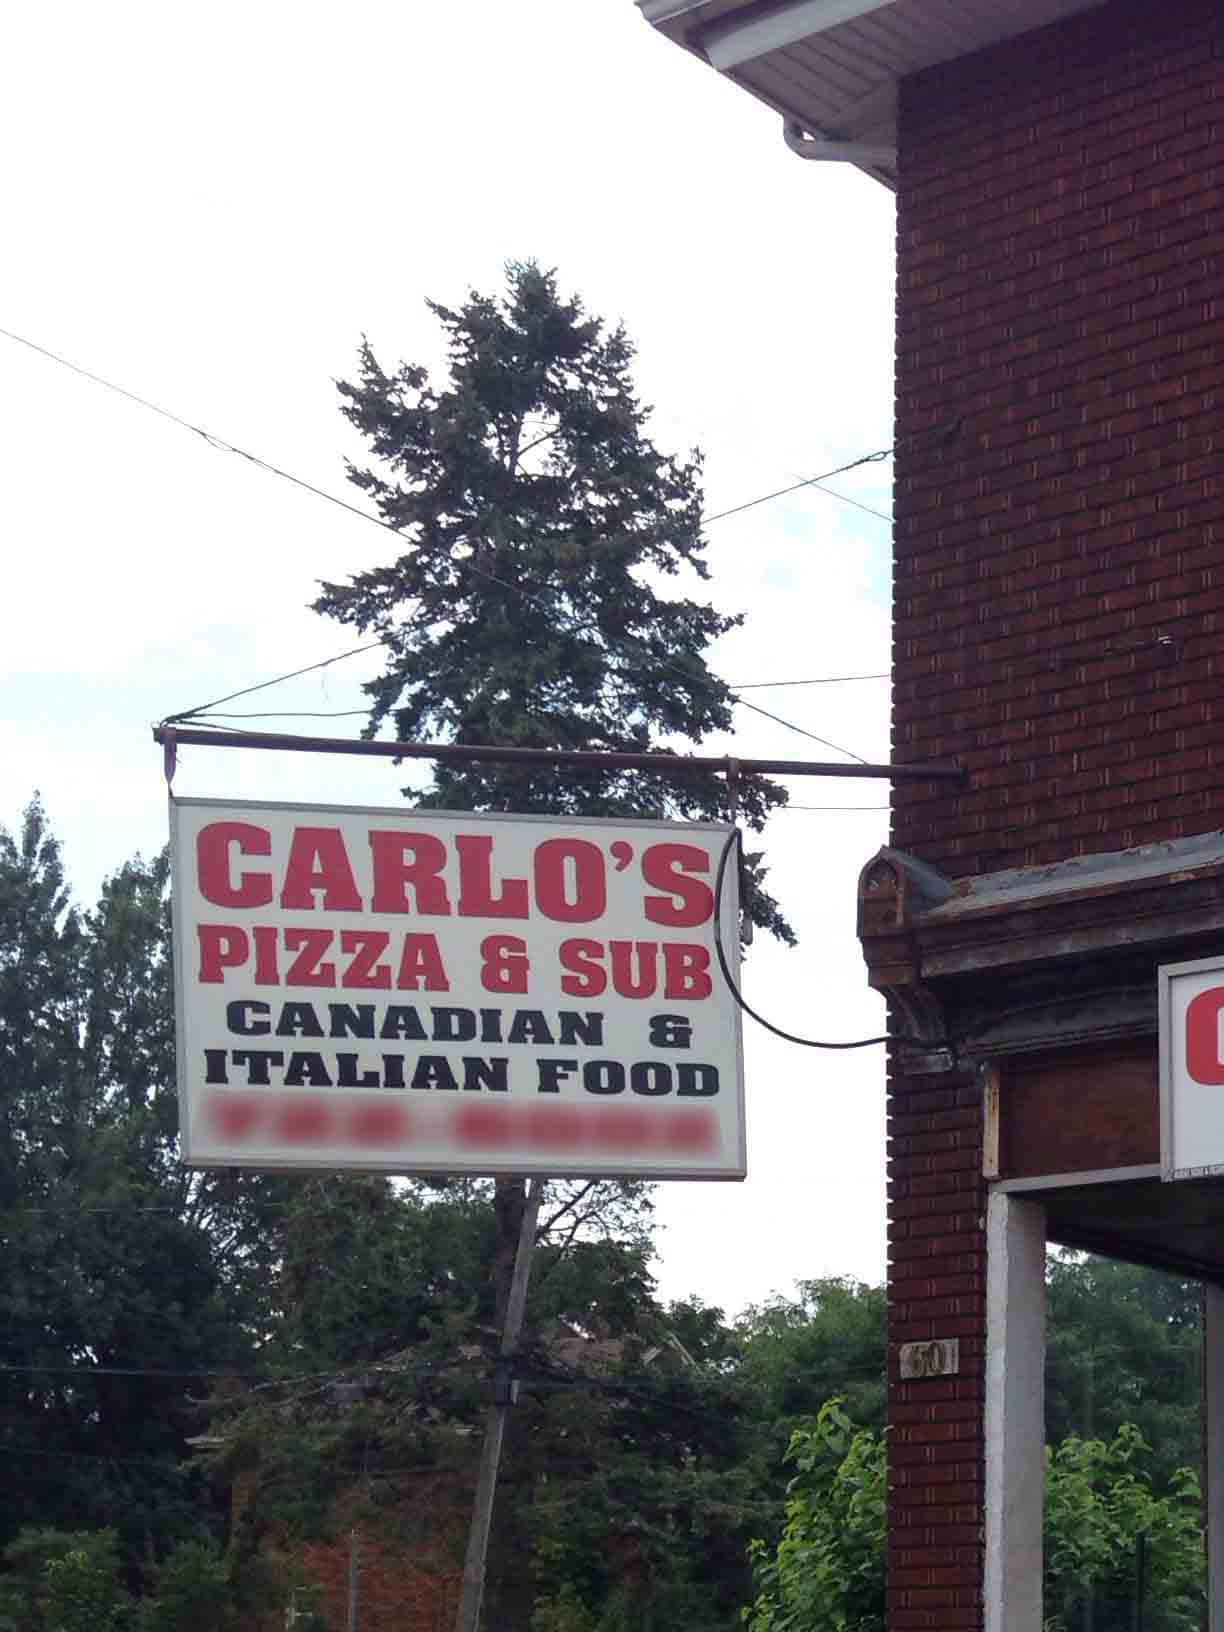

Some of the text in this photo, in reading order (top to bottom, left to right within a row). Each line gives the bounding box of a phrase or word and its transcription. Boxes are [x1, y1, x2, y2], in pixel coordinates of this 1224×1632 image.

[196, 821, 716, 928] CARLO'S
[197, 924, 713, 1000] PIZZA & SUB
[226, 999, 693, 1049] CANADIAN &
[203, 1048, 720, 1097] ITALIAN FOOD
